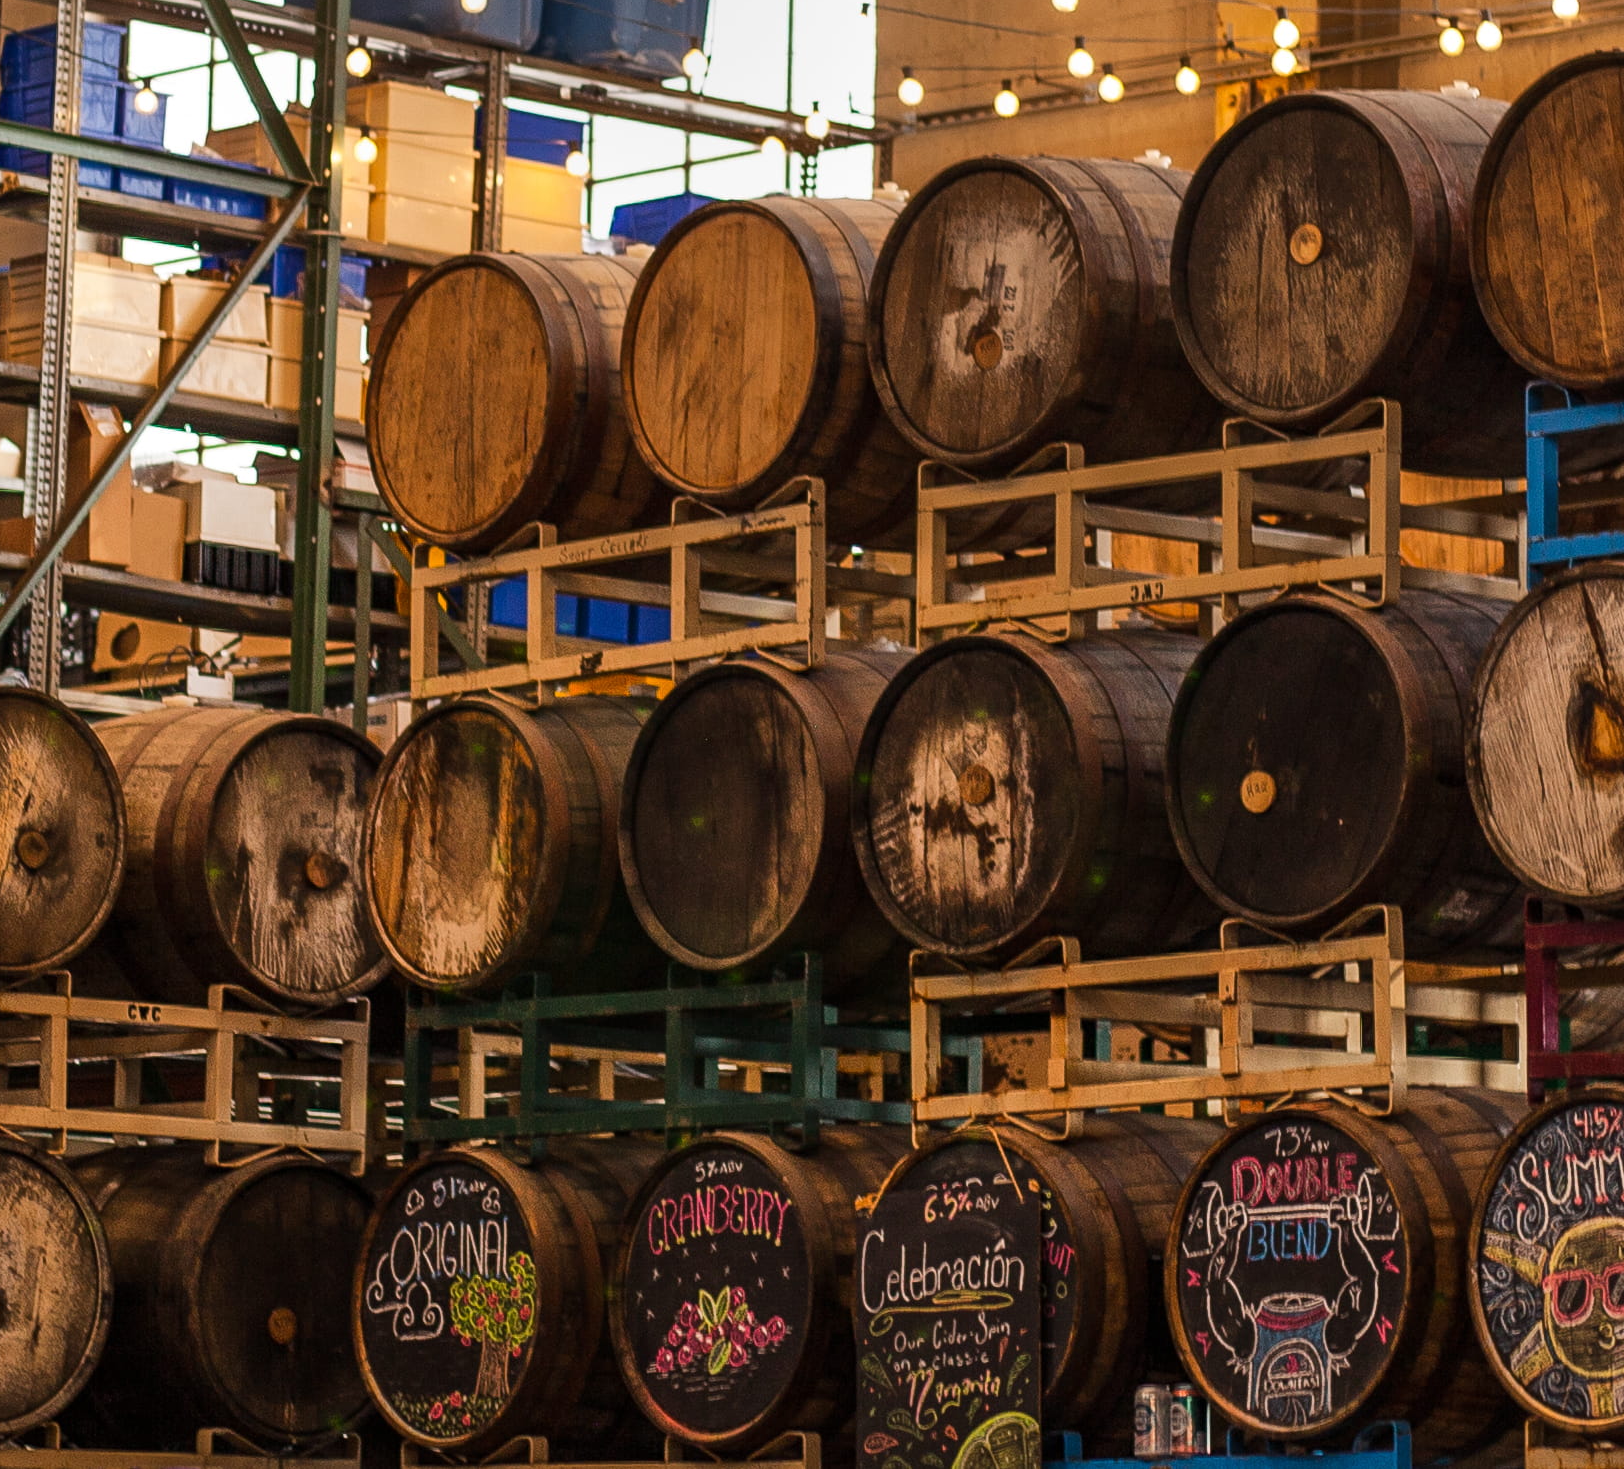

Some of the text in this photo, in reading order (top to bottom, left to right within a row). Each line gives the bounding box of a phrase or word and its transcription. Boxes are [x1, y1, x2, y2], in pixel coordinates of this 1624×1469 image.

[128, 1004, 161, 1022] CWC
[647, 1184, 792, 1255] CRANBERRY
[924, 1192, 973, 1224] 6.5%
[390, 1215, 512, 1286] ORIGINAL
[1247, 1218, 1332, 1262] BLEND
[861, 1228, 1025, 1313] Celebración
[894, 1330, 925, 1353] Our
[894, 1359, 911, 1372] on
